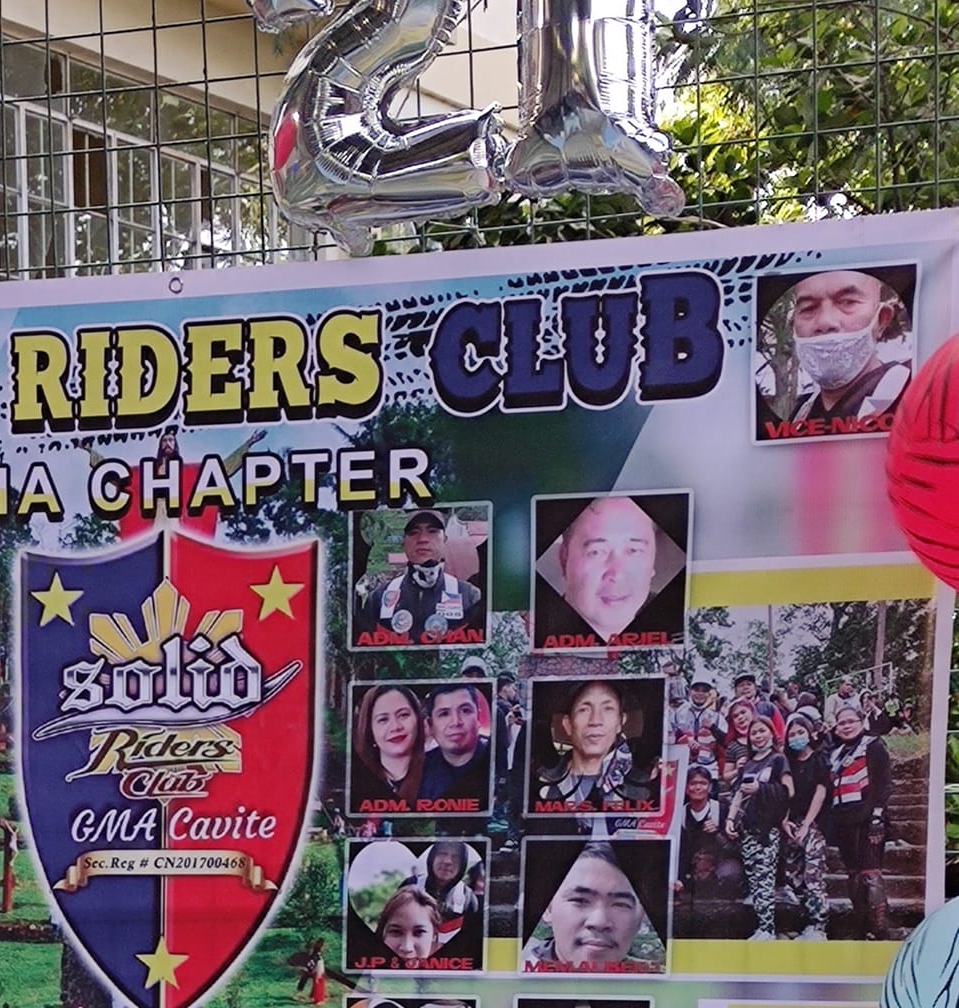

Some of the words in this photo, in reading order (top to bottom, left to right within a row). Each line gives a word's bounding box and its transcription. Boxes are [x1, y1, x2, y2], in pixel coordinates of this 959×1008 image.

[9, 309, 384, 433] RIDERS
[429, 269, 724, 415] CLUB
[89, 448, 433, 515] CHAPTER
[66, 726, 238, 781] Riders
[120, 767, 211, 799] Club
[359, 799, 411, 812] ADM.
[71, 807, 157, 842] GMA
[169, 806, 277, 841] Cavite
[154, 857, 246, 870] CN201700468
